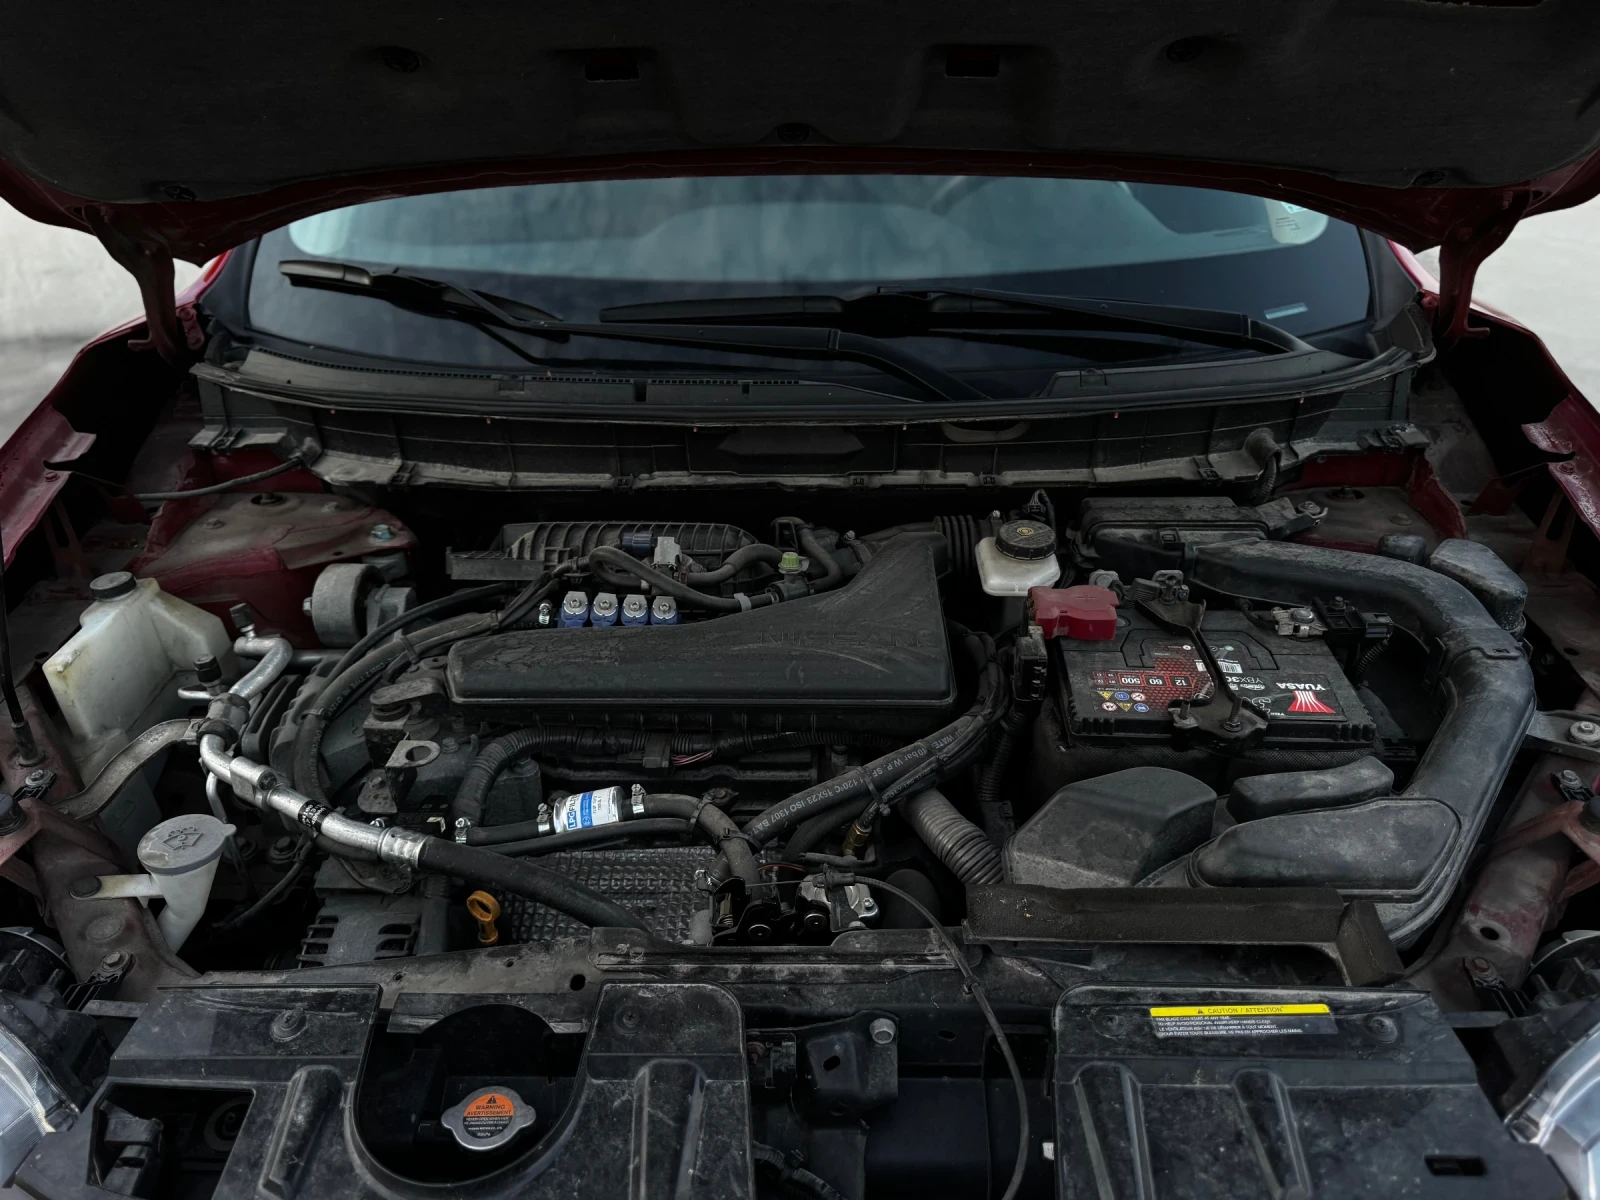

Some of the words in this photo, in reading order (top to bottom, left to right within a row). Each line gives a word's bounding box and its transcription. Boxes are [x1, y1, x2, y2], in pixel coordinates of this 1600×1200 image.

[1121, 677, 1141, 685] 500
[1275, 682, 1327, 691] YUASA
[789, 801, 805, 812] ISO
[568, 812, 576, 828] LPG
[771, 808, 789, 822] 1307
